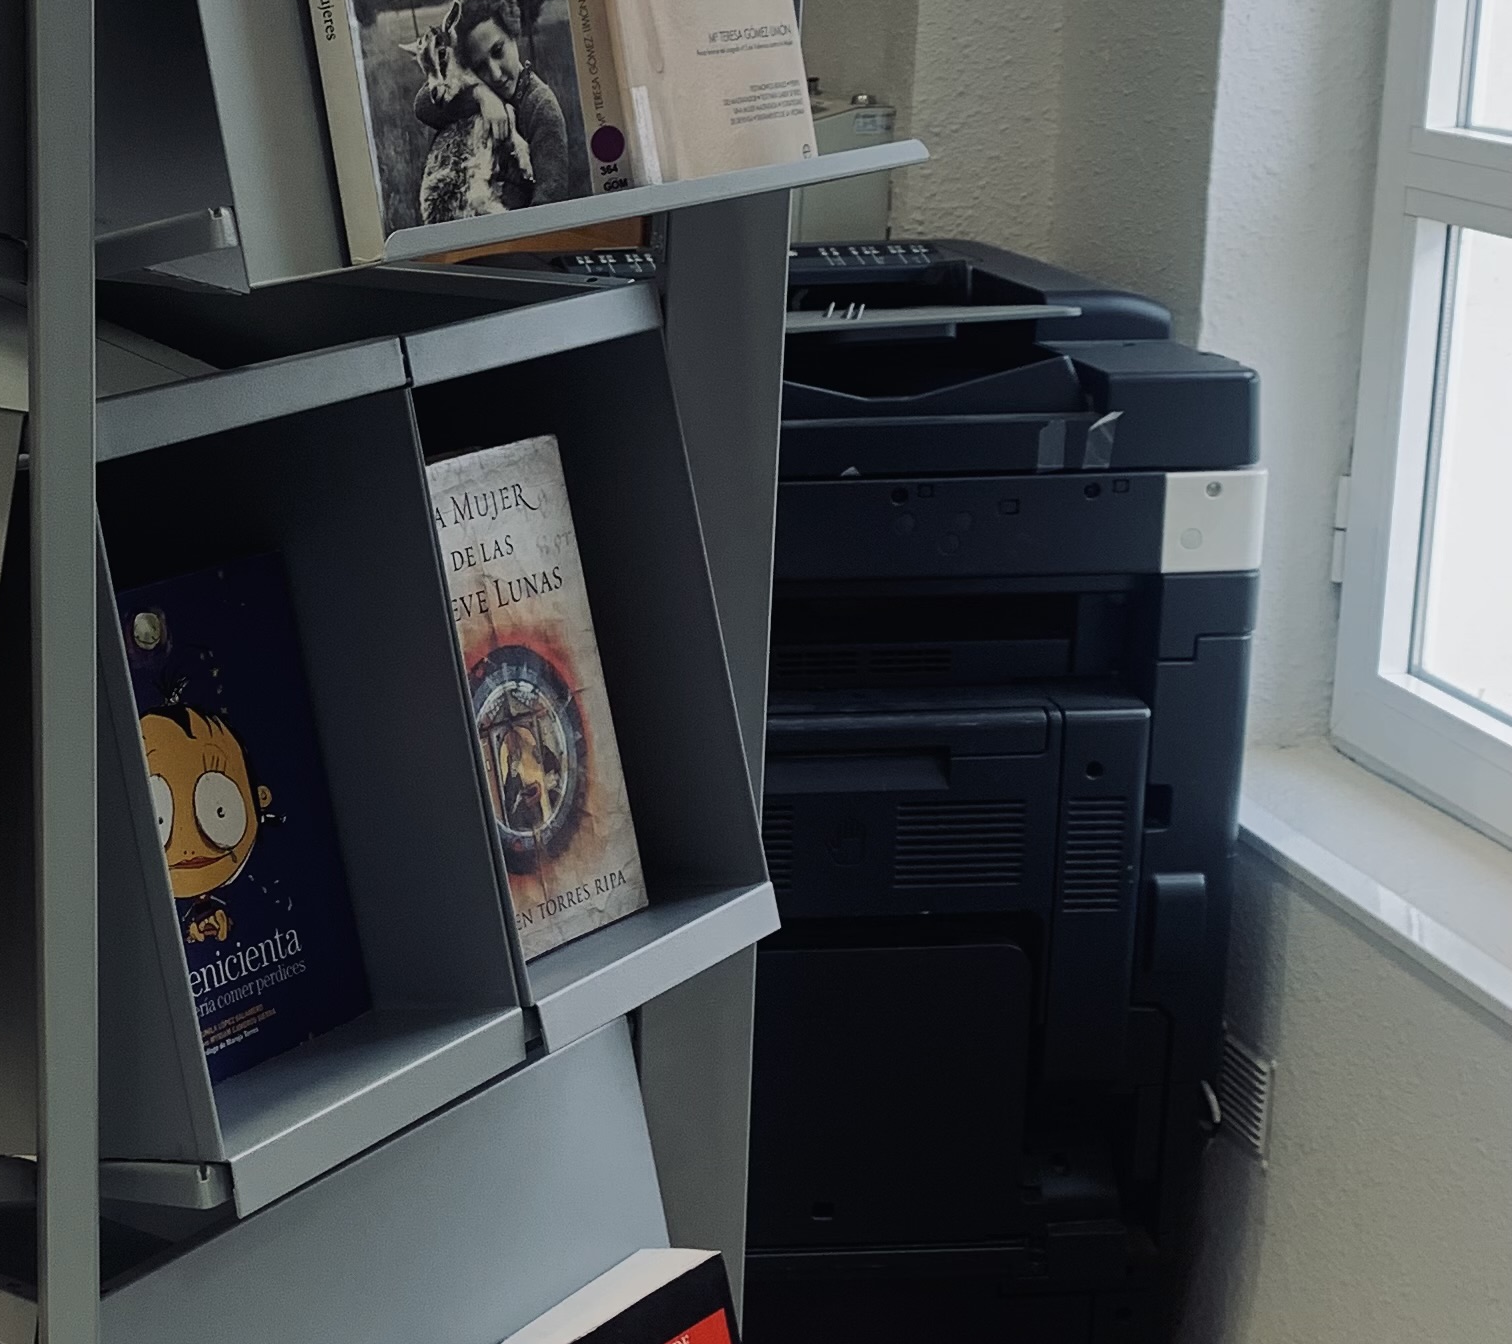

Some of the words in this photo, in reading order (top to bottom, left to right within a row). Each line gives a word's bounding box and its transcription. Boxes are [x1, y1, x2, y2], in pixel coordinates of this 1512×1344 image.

[719, 29, 743, 42] TERESA
[591, 76, 605, 111] TERESA
[600, 164, 619, 176] 364
[603, 178, 628, 192] GOM
[450, 483, 538, 525] MUJER
[450, 546, 477, 572] DE
[480, 534, 514, 563] LAS
[493, 566, 563, 608] LUNAS
[537, 883, 591, 920] TORRES
[594, 869, 627, 895] RIPA
[217, 981, 255, 1007] comer
[256, 959, 307, 996] perdices
